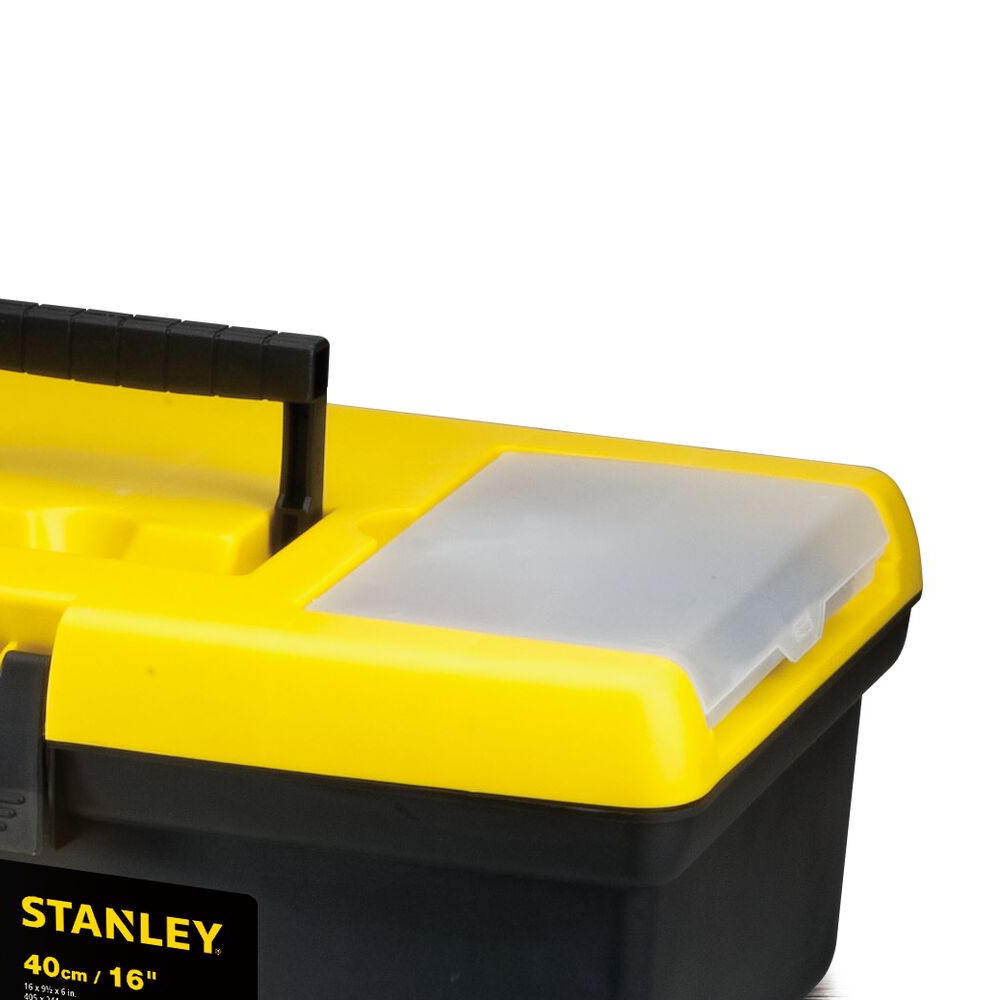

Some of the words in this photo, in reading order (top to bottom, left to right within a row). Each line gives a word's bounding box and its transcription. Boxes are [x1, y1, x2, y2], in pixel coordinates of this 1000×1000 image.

[21, 895, 223, 955] STANLEY
[23, 954, 88, 983] 40cm
[109, 966, 157, 991] 16"
[24, 982, 33, 991] 16
[67, 989, 77, 998] in.
